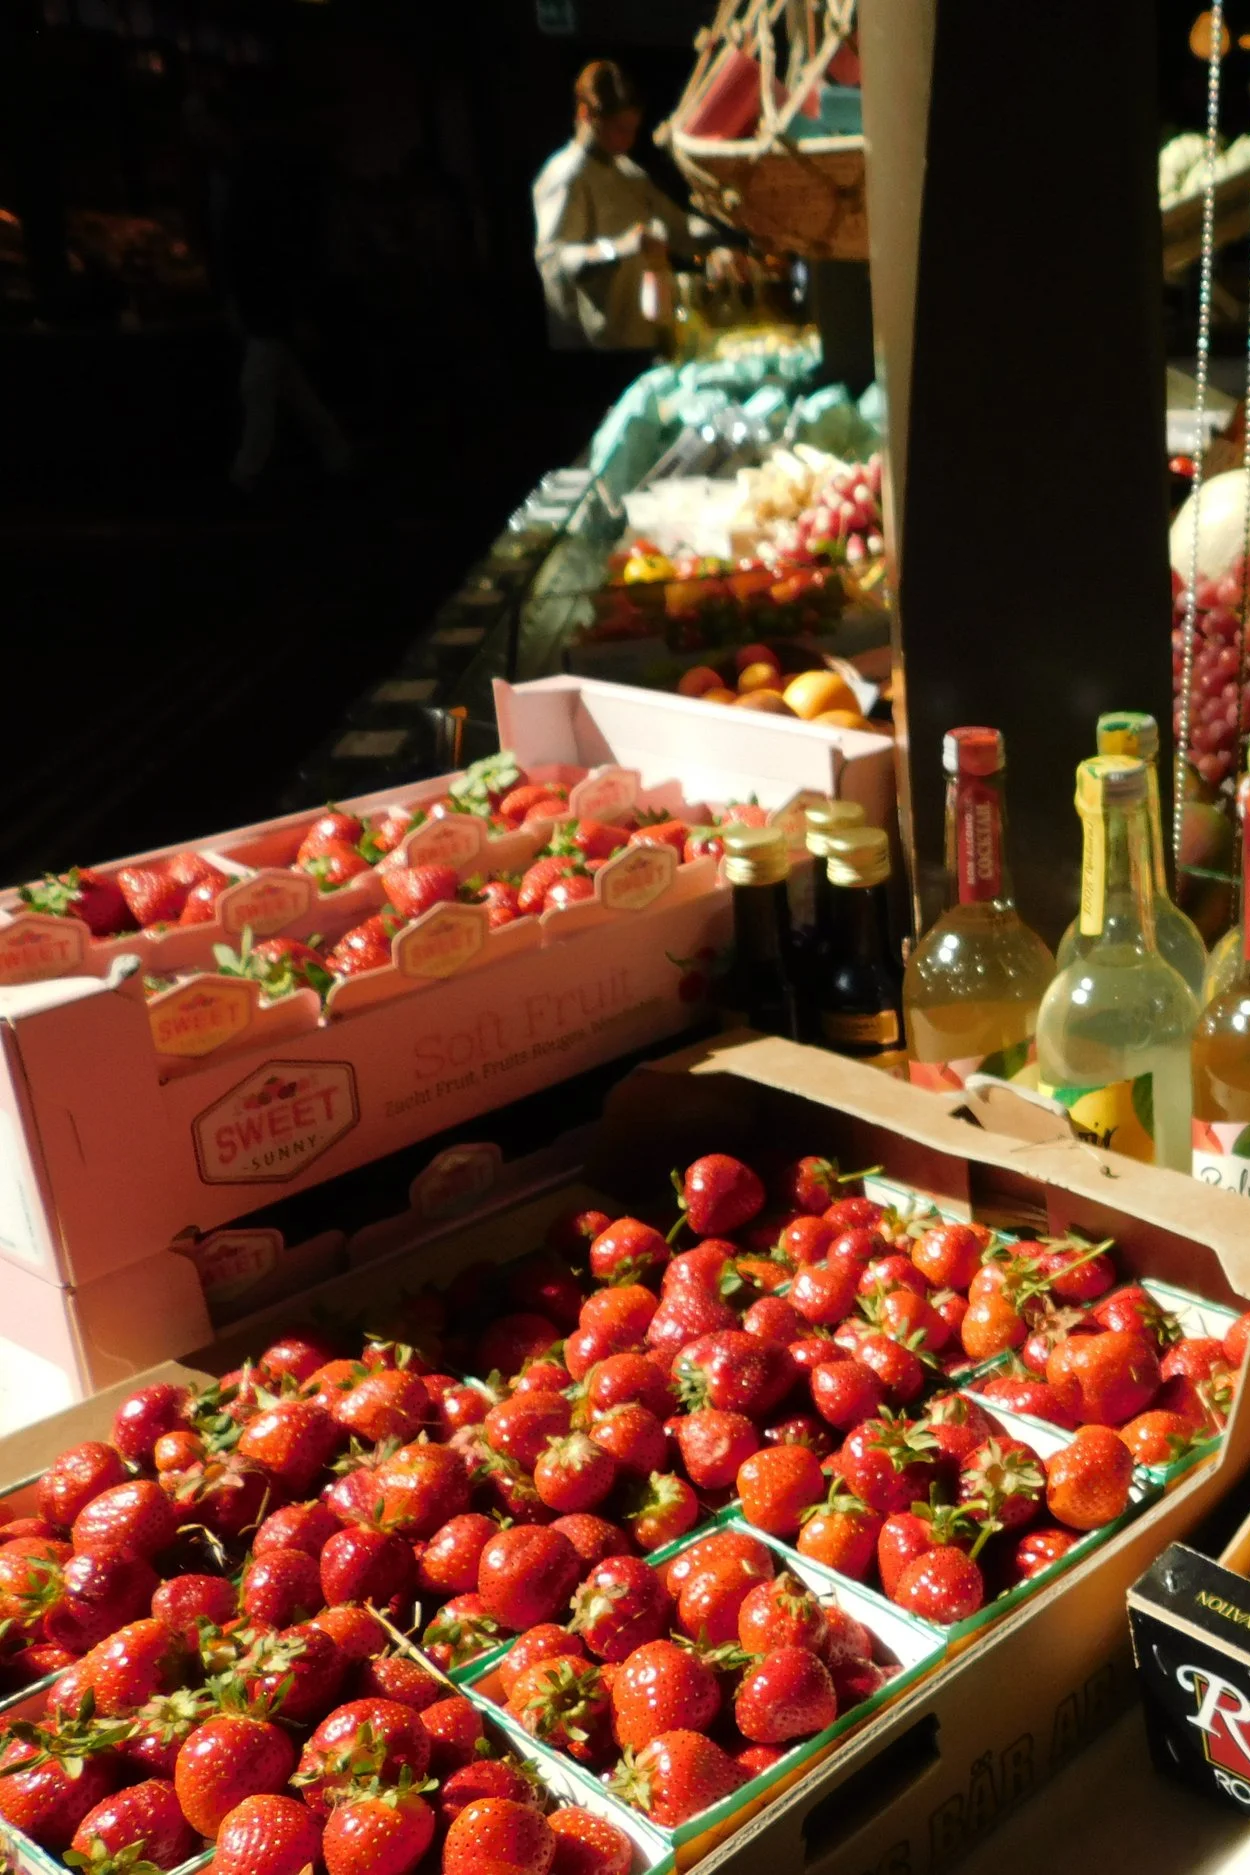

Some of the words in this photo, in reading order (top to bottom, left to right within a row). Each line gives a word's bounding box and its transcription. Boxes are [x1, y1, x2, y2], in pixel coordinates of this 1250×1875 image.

[976, 801, 994, 881] COCKTAIL
[413, 1009, 510, 1079] Soft
[523, 967, 634, 1037] Fruit
[215, 1086, 339, 1164] SWEET
